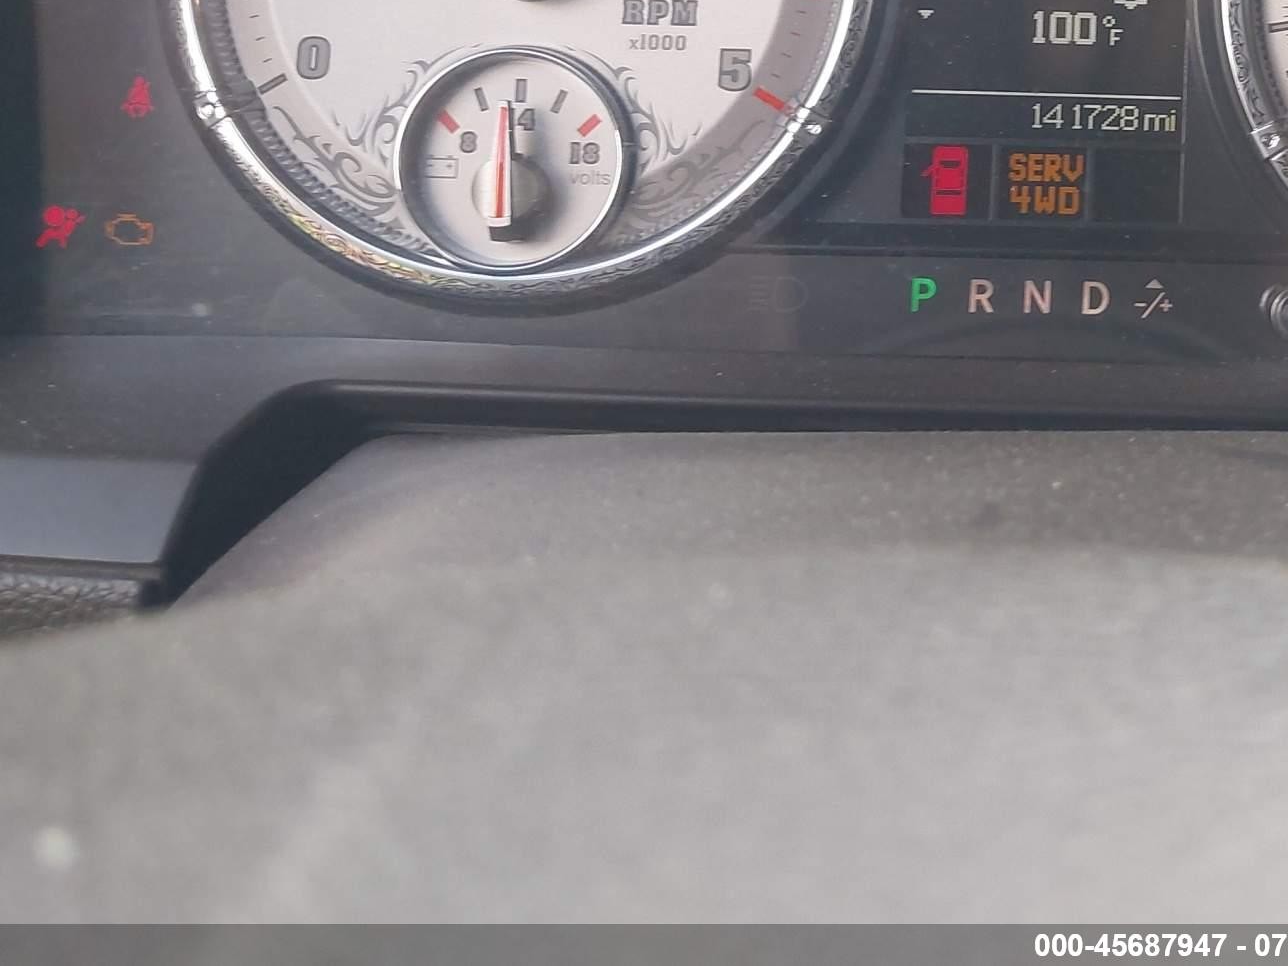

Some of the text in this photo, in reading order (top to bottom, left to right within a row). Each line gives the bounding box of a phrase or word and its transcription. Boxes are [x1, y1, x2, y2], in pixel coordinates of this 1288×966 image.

[296, 35, 331, 80] 0
[628, 34, 687, 52] x1000
[719, 47, 752, 91] 5
[459, 131, 478, 153] 8
[568, 142, 600, 164] 18
[570, 170, 612, 185] volts
[1009, 152, 1084, 183] SERV
[1009, 186, 1080, 216] 4WD
[911, 277, 937, 312] P
[967, 279, 994, 314] R
[1023, 280, 1052, 315] N
[1081, 281, 1110, 316] D
